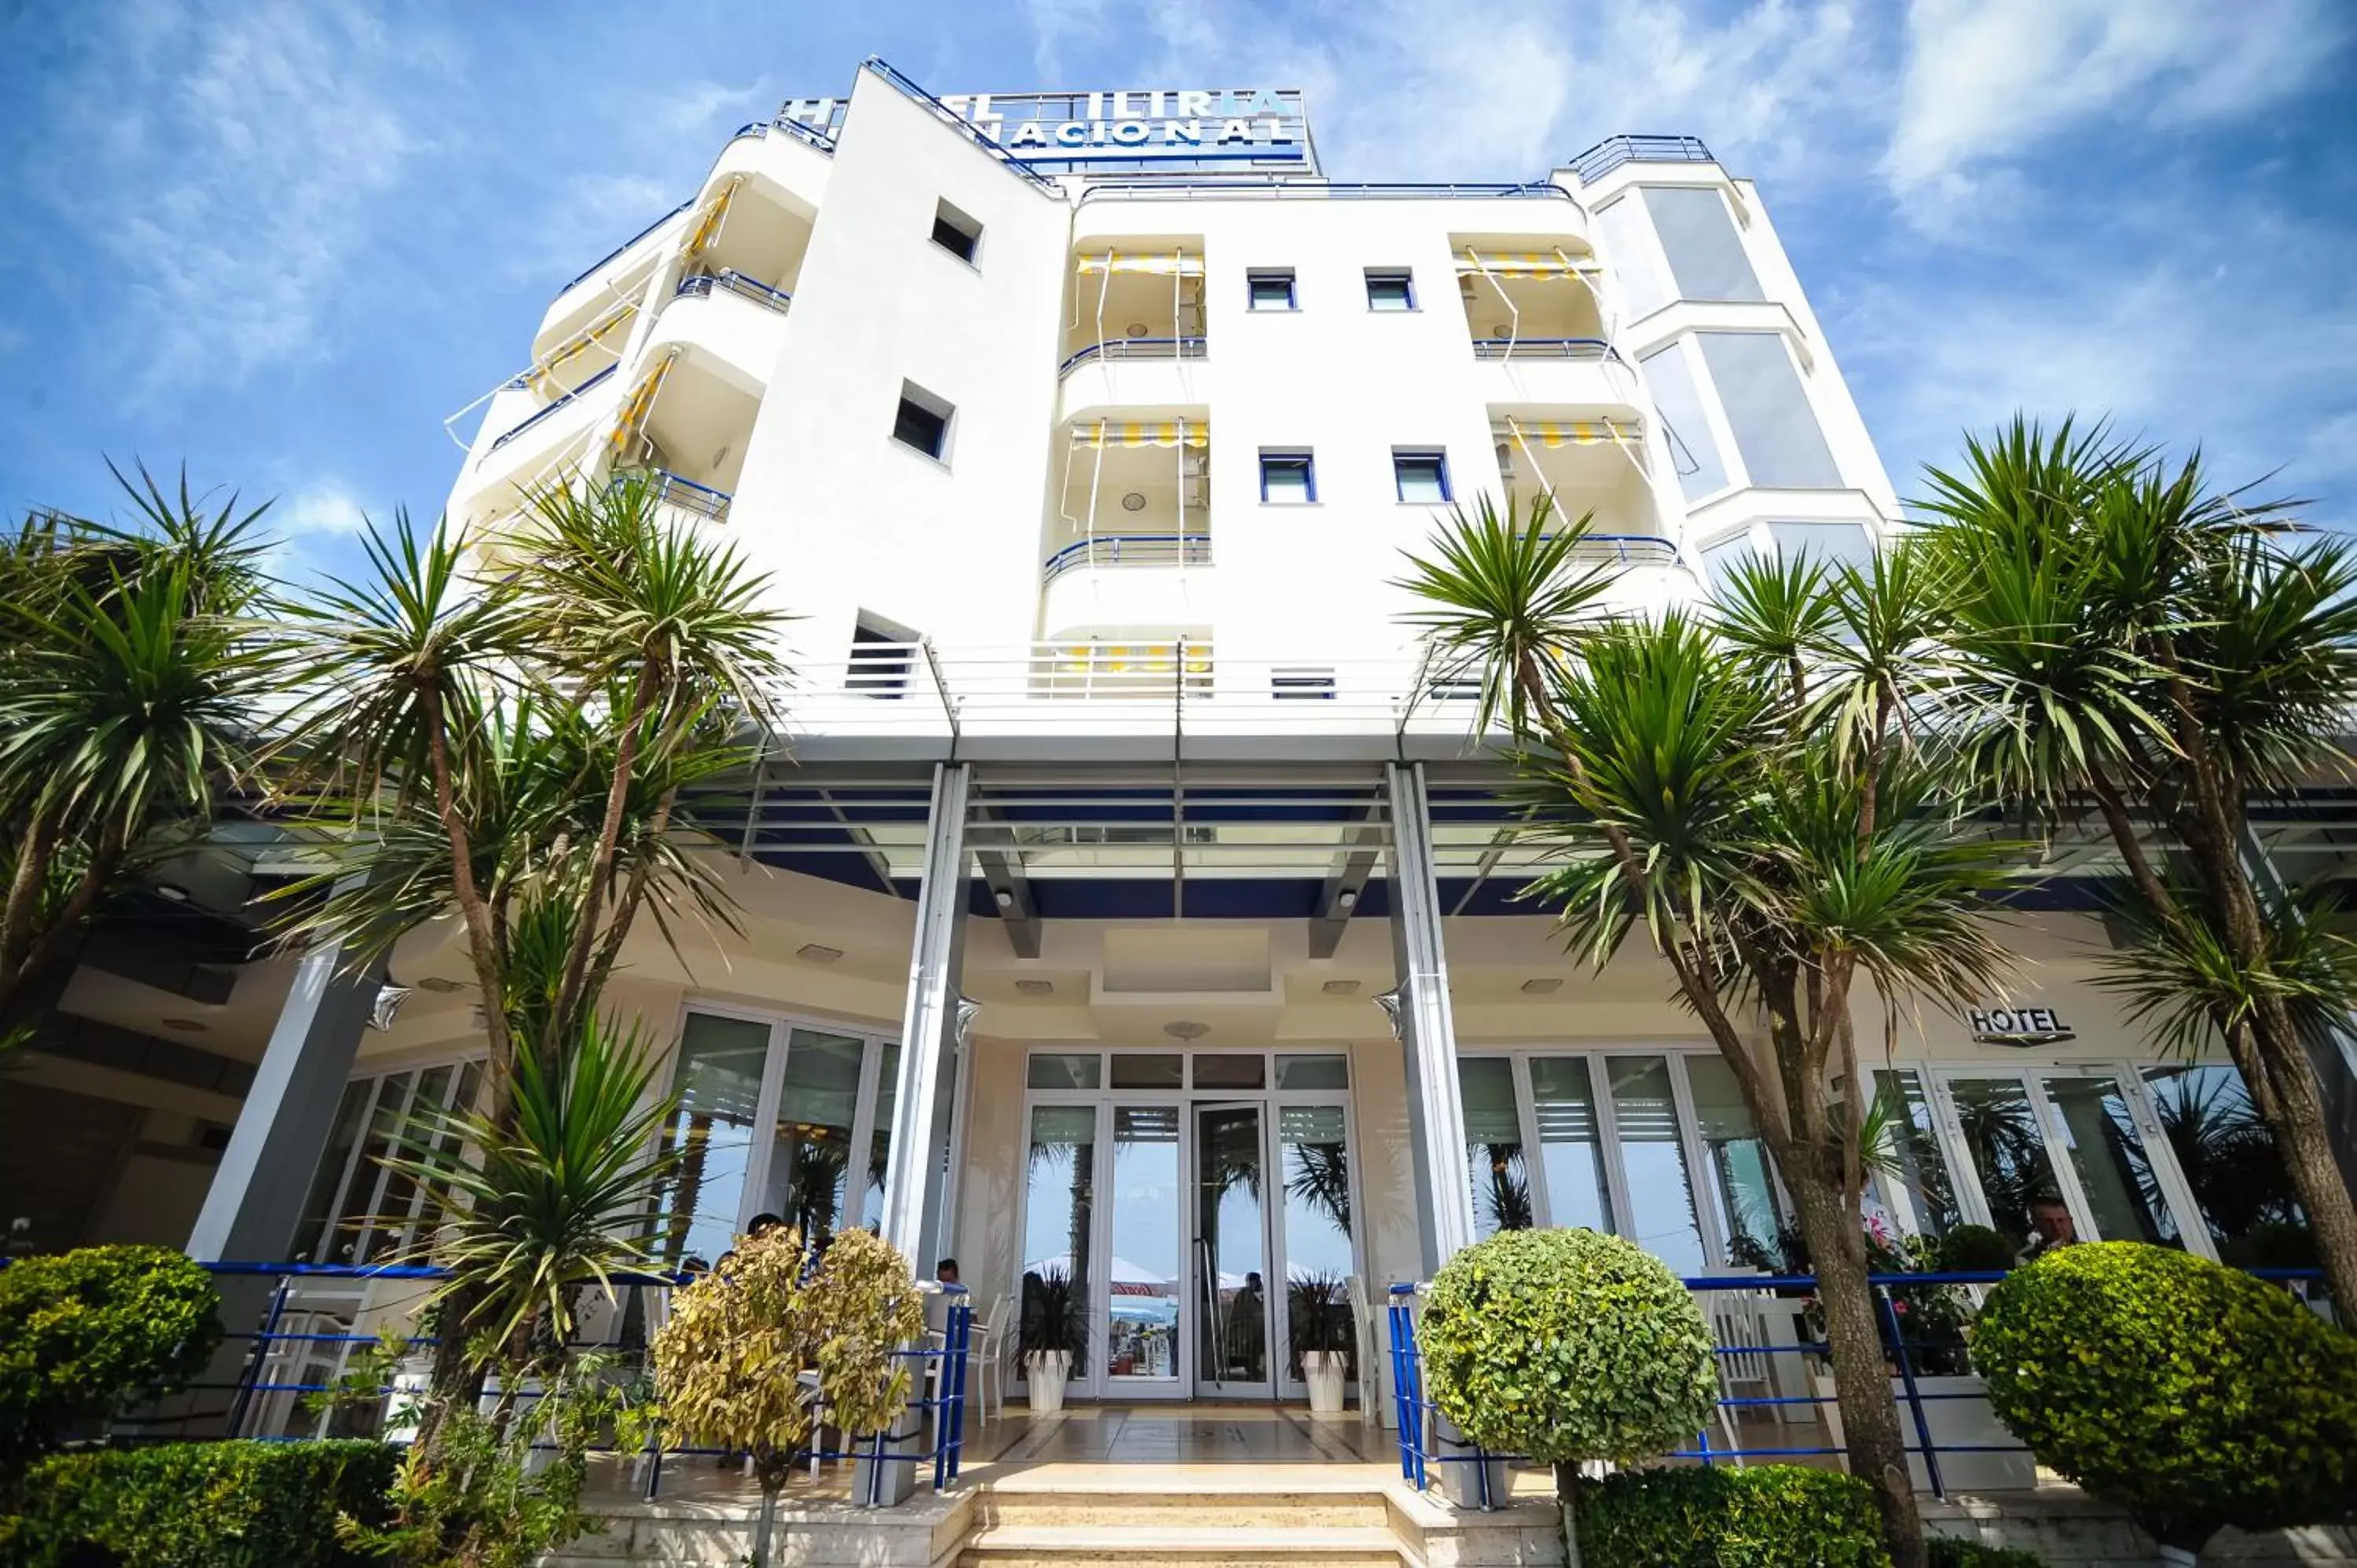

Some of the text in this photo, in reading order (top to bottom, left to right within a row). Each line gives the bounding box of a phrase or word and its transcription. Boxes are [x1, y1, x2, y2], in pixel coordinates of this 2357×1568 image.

[787, 90, 1292, 124] HEL ILIRIA
[1967, 1008, 2071, 1032] HOTEL
